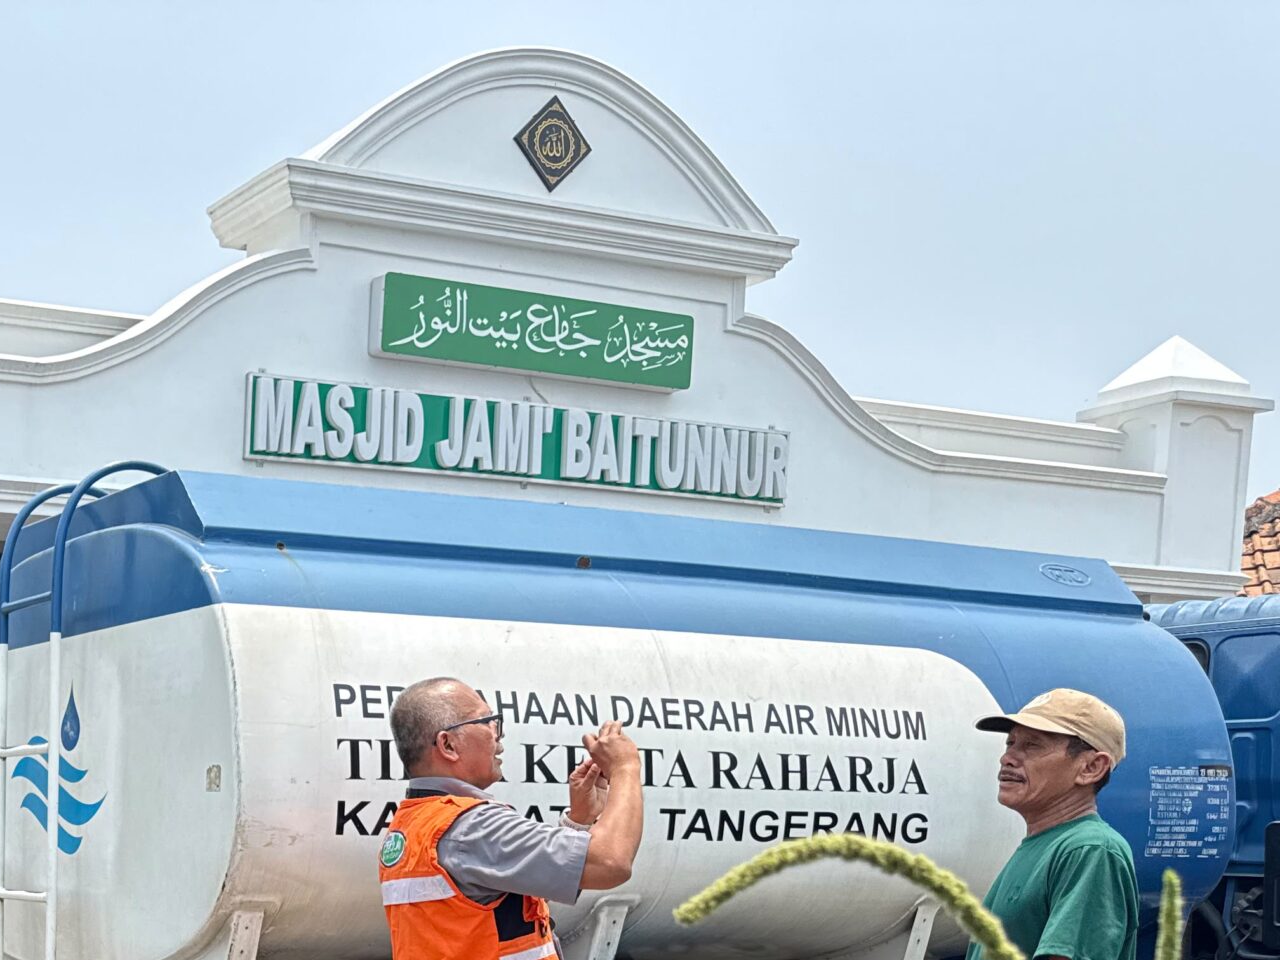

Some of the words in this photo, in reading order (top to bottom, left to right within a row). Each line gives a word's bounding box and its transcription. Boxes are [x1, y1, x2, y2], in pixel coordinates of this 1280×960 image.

[253, 376, 425, 464] MASJID
[434, 395, 555, 477] JAMI'
[560, 408, 789, 500] BAITUNNUR
[333, 683, 600, 727] PEHAAN
[610, 695, 754, 733] DAERAH
[764, 703, 818, 736] AIR
[825, 706, 928, 741] MINUM
[520, 743, 699, 789] KETA
[708, 750, 929, 795] RAHARJA
[659, 808, 929, 844] TANGERANG
